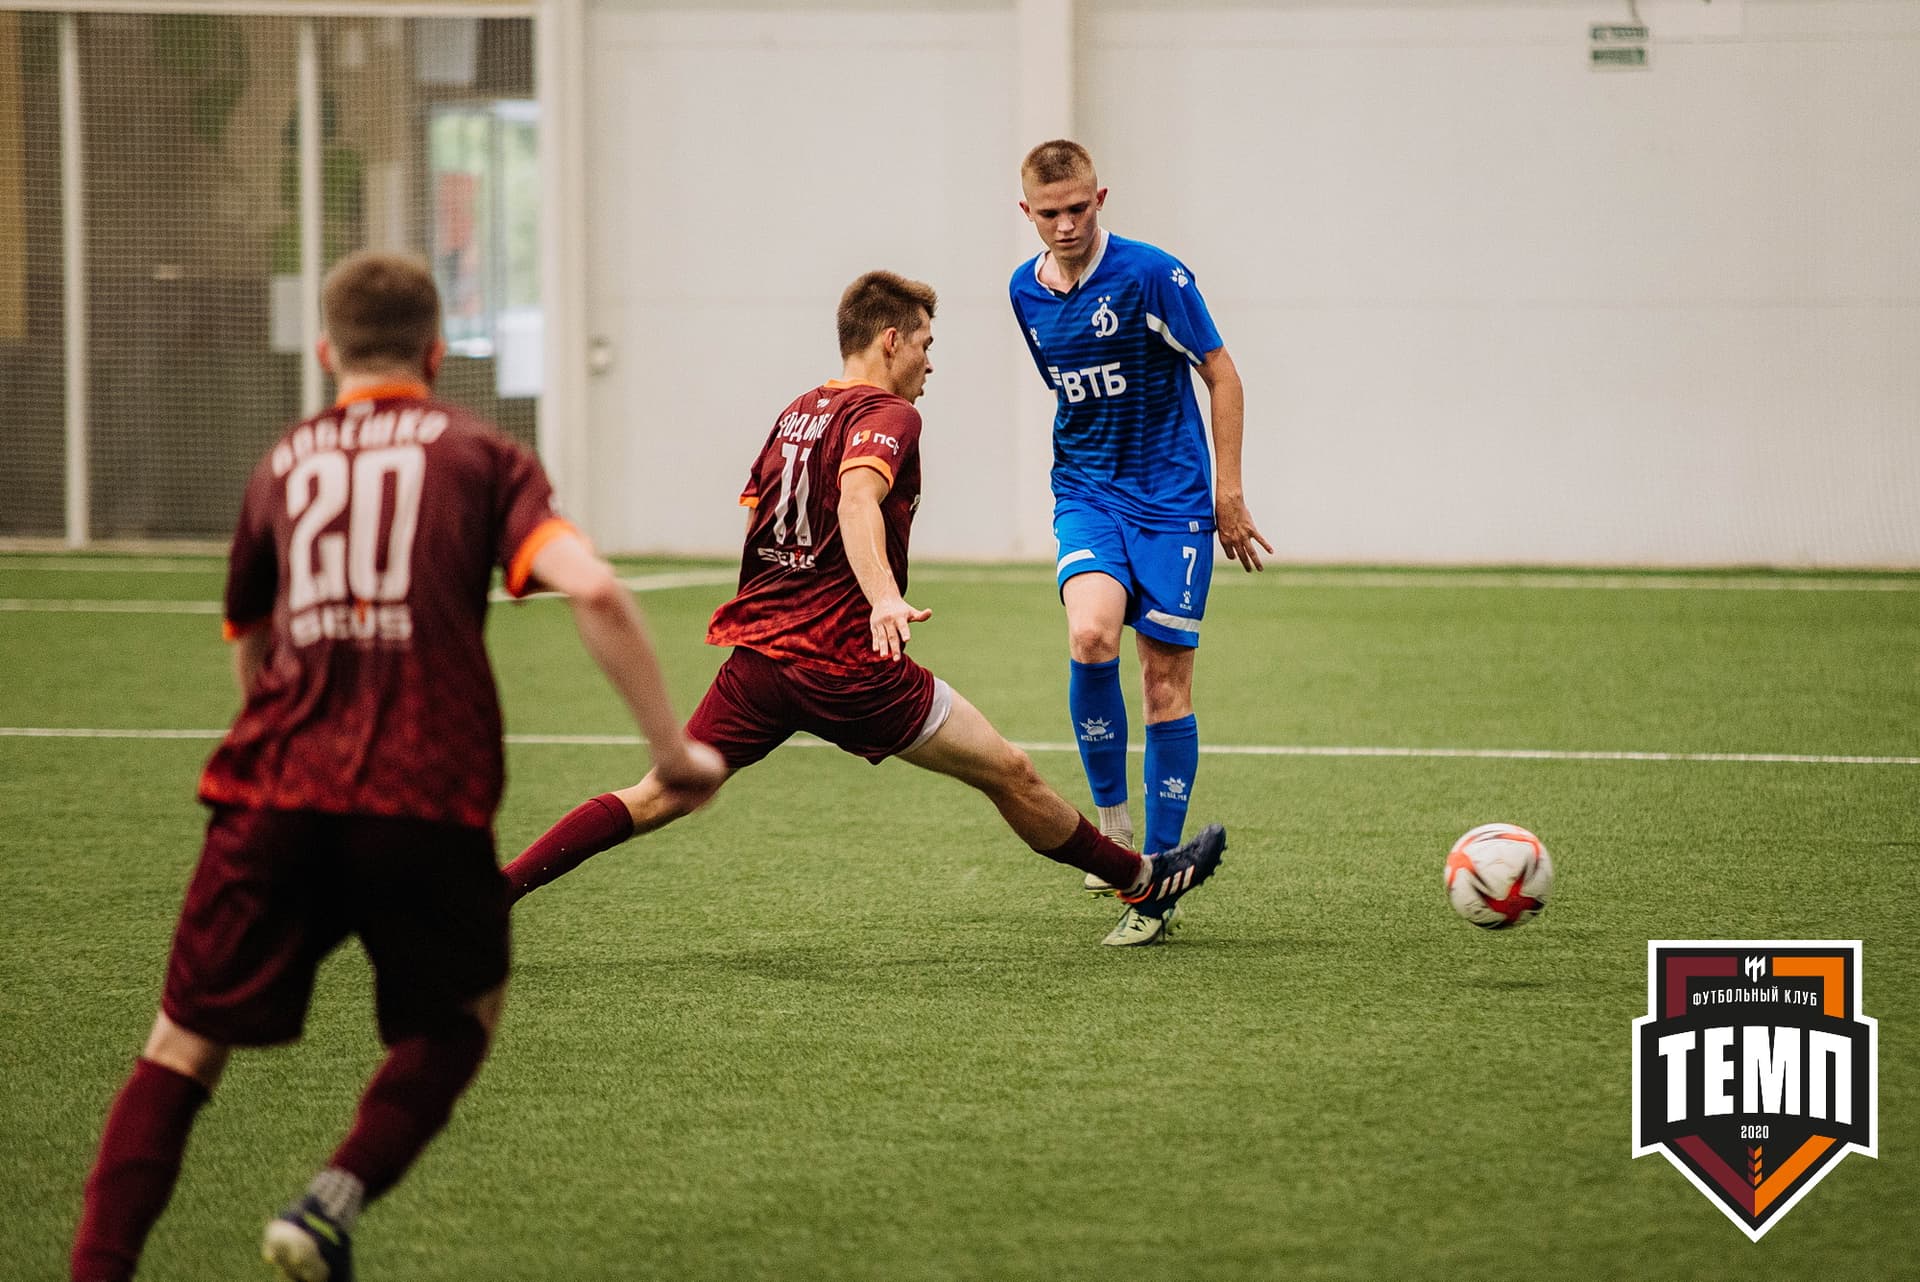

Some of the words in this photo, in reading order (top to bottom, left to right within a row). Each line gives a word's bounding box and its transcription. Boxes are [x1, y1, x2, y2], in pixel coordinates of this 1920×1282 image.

[1061, 362, 1127, 403] ВТБ
[286, 446, 426, 612] 20
[772, 442, 813, 546] 11
[1182, 546, 1197, 585] 7
